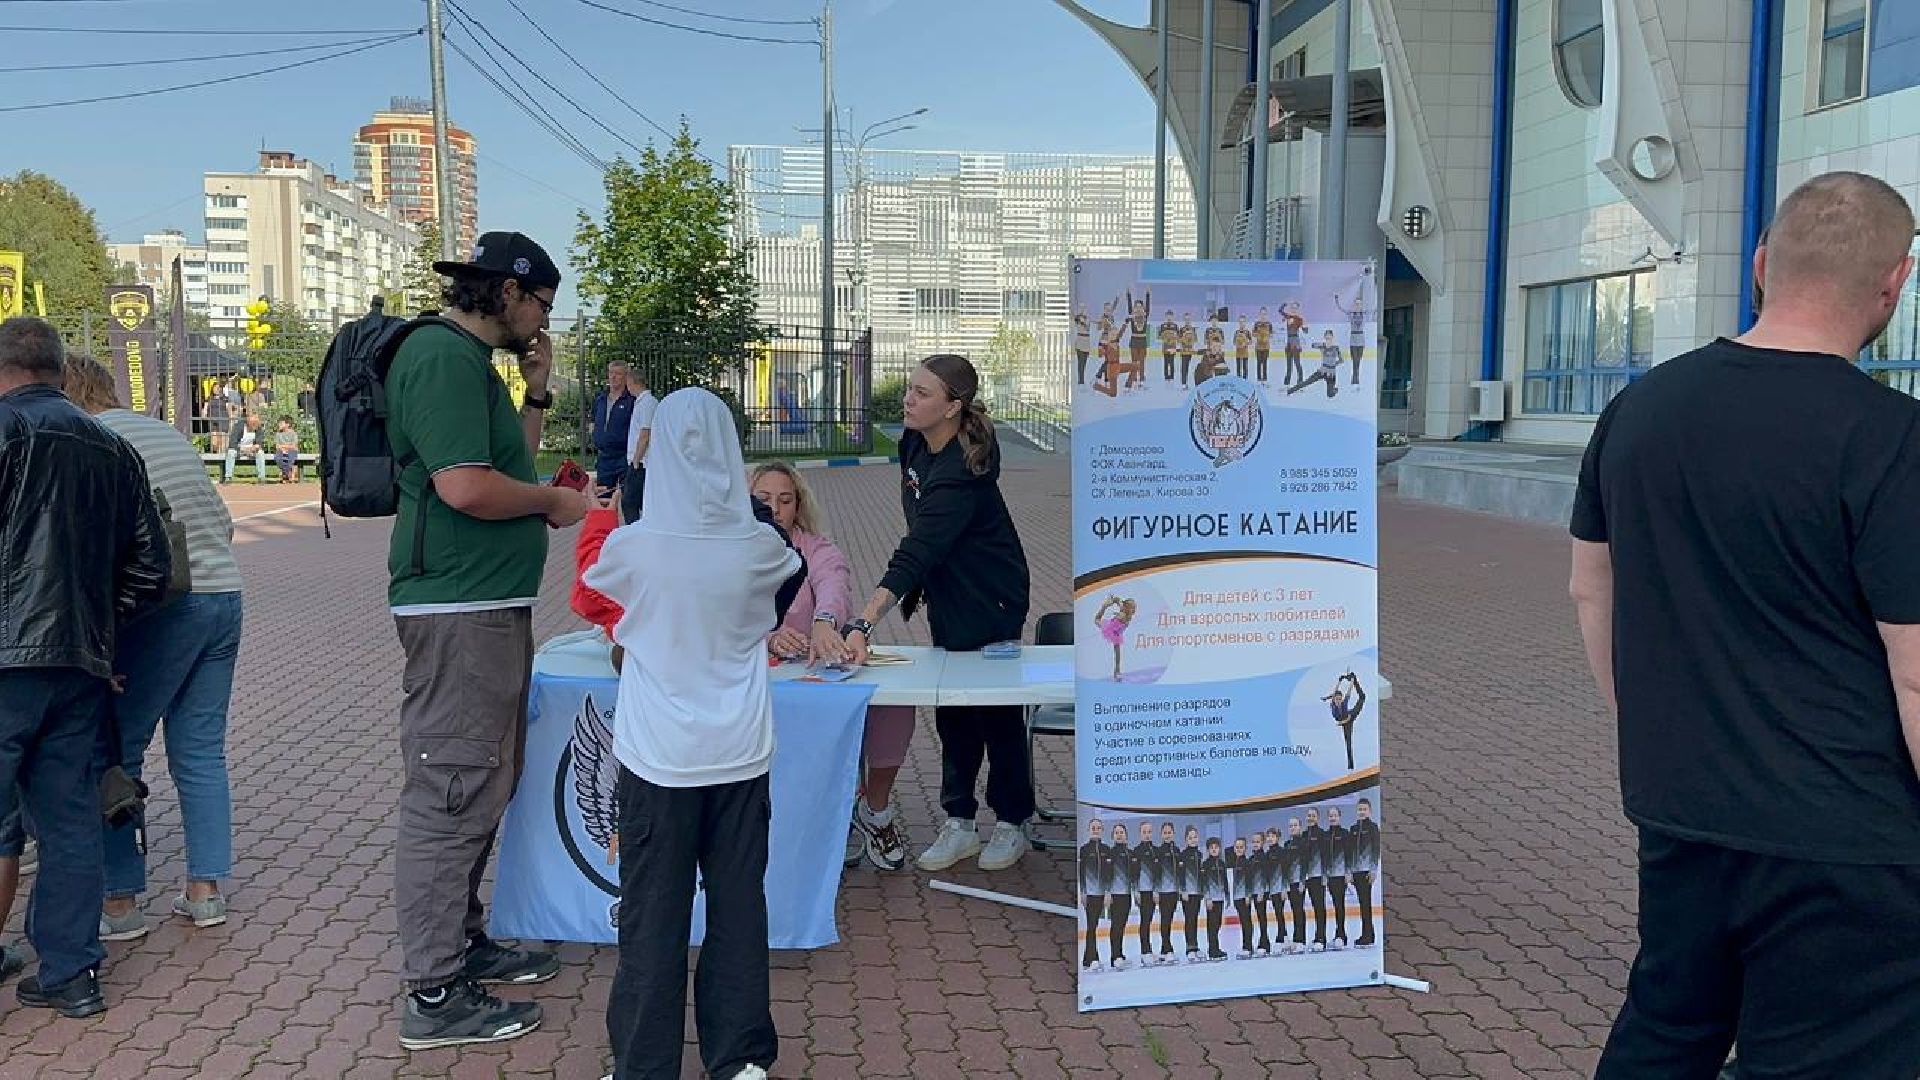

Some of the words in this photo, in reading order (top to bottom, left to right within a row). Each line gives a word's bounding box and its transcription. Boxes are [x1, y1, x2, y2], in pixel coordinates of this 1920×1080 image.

[126, 341, 146, 411] DOMODEDOVO
[1099, 445, 1165, 456] Домодедово
[1110, 472, 1207, 486] Коммунистическая
[1280, 468, 1288, 479] 8
[1157, 486, 1194, 499] Кирова
[1280, 482, 1288, 493] 8
[1092, 513, 1229, 540] ФИГУРНОЕ
[1240, 510, 1358, 536] КАТАНИЕ
[1183, 590, 1213, 606] Для
[1216, 589, 1259, 604] детей
[1263, 591, 1272, 601] с
[1276, 588, 1285, 601] 3
[1289, 589, 1314, 601] лет
[1158, 612, 1186, 628] Для
[1190, 611, 1260, 629] взрослых
[1263, 606, 1346, 623] любителей
[1135, 633, 1165, 649] Для
[1168, 631, 1262, 649] спортсменов
[1267, 631, 1276, 642] с
[1280, 628, 1360, 645] разрядами
[1094, 702, 1171, 716] Выполнение
[1173, 697, 1231, 713] разрядов
[1095, 723, 1101, 732] в
[1104, 718, 1172, 733] одиночном
[1175, 715, 1223, 727] катании
[1094, 736, 1145, 750] Участие
[1149, 736, 1156, 746] в
[1158, 731, 1251, 747] соревнованиях
[1094, 755, 1132, 768] среди
[1134, 750, 1206, 766] спортивных
[1209, 746, 1259, 759] балетов
[1262, 746, 1277, 757] на
[1095, 774, 1102, 784] в
[1105, 770, 1154, 784] составе
[1157, 767, 1212, 781] команды
